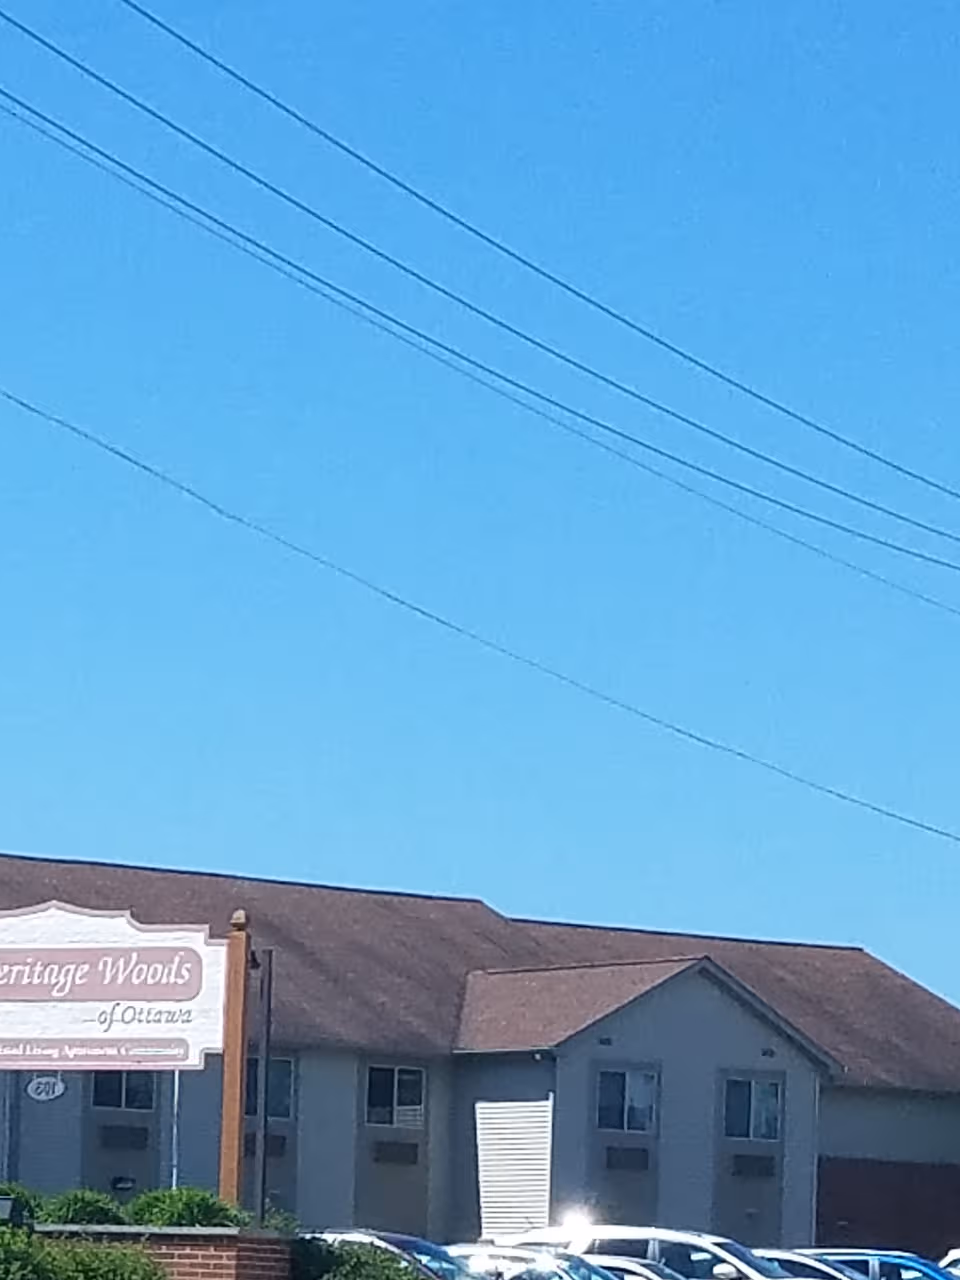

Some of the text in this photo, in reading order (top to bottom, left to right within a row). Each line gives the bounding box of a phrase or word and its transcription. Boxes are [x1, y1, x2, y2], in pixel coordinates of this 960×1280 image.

[99, 952, 192, 985] Woods
[98, 1002, 192, 1032] of Ottawa
